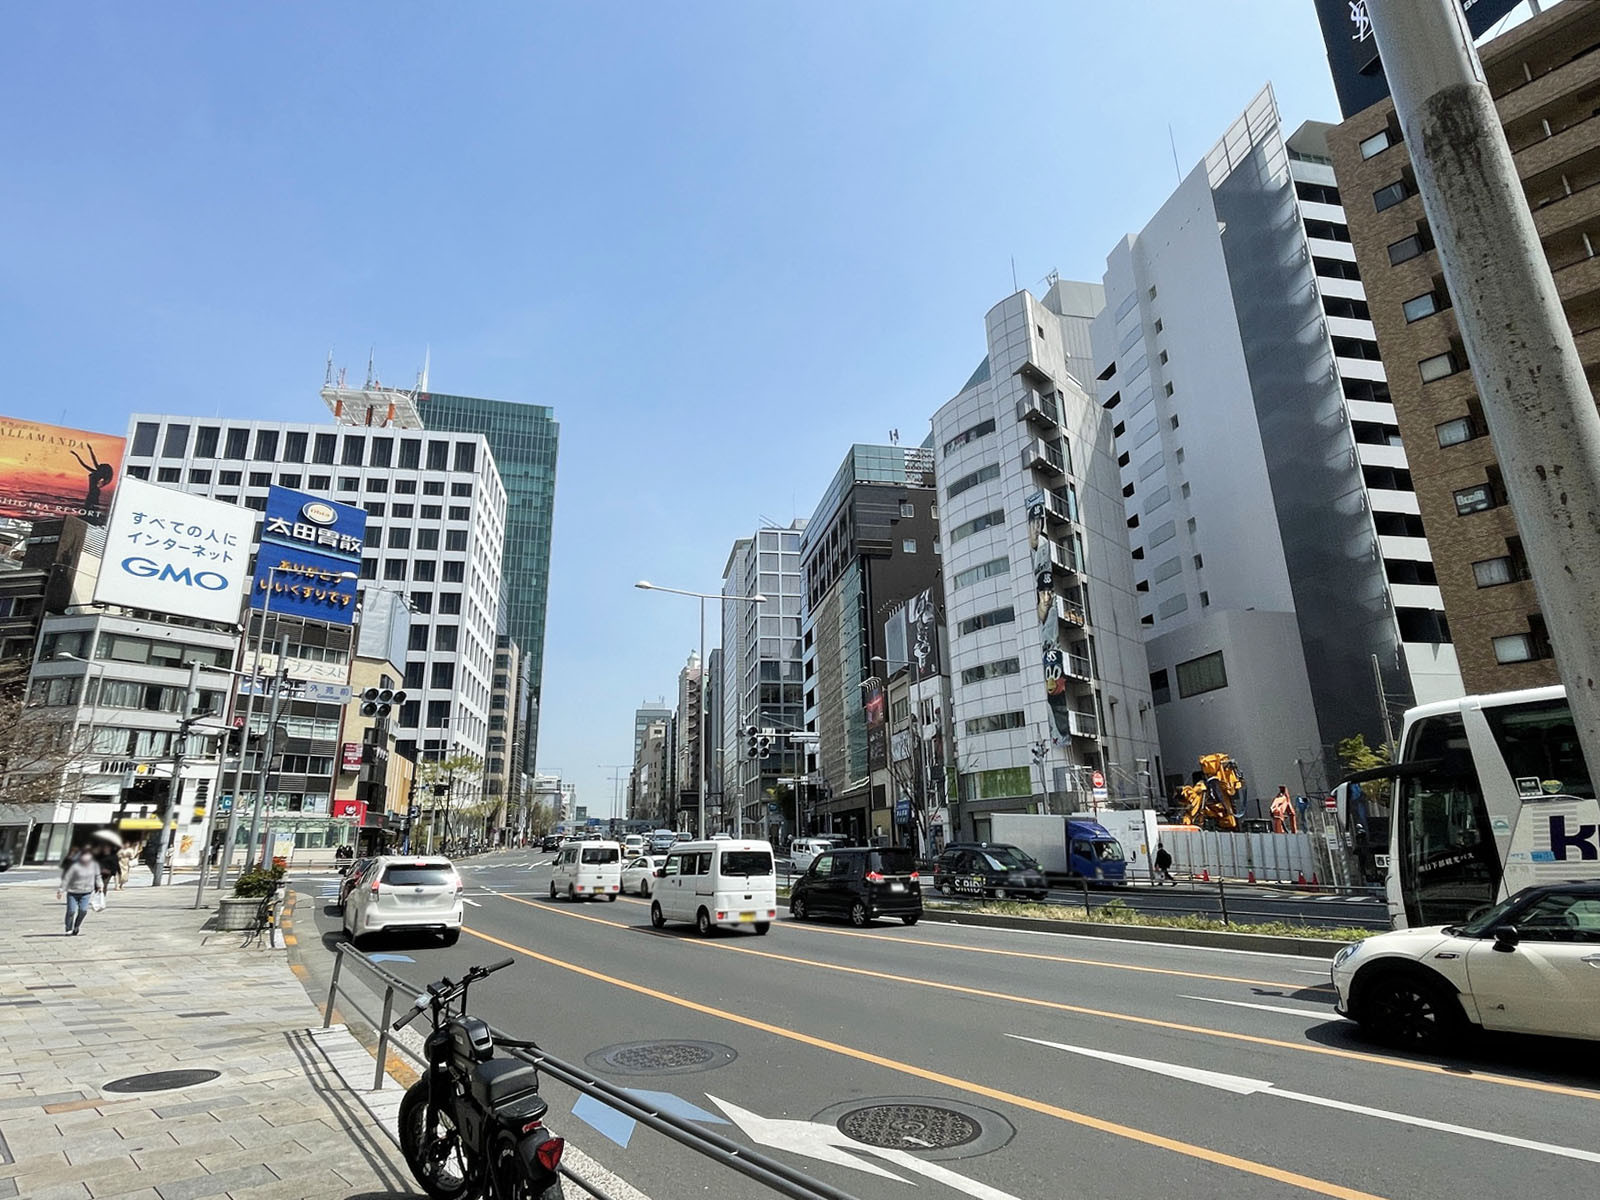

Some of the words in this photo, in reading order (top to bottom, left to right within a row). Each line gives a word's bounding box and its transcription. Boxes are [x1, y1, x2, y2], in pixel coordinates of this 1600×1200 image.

[55, 505, 102, 518] RESORT
[132, 512, 237, 546] すべての人に
[266, 517, 362, 553] 太田胃散
[128, 532, 233, 563] インターネット
[121, 557, 229, 591] GMO
